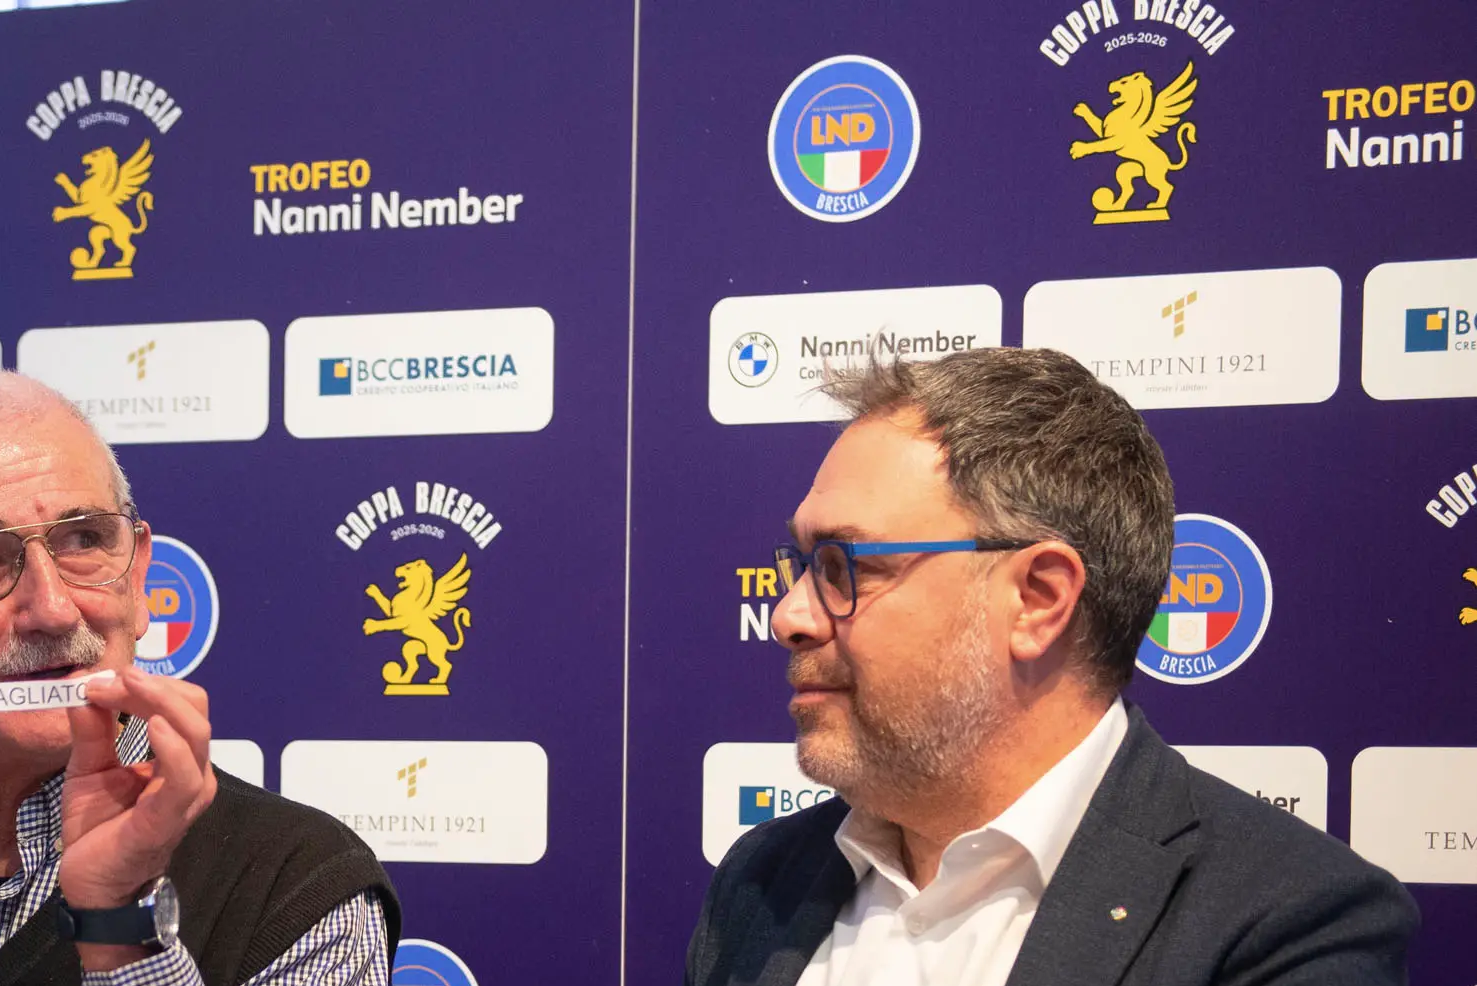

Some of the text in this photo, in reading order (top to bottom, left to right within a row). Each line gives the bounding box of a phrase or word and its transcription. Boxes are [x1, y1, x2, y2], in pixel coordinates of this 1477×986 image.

[1104, 32, 1168, 52] 2025-2026
[26, 69, 183, 141] COPPA BRESCIA
[1322, 80, 1476, 121] TROFEO
[811, 112, 876, 146] LND
[1326, 119, 1463, 169] Nanni
[250, 159, 371, 192] TROFEO
[254, 187, 523, 235] Nanni Nember
[816, 191, 869, 212] BRESCIA
[801, 330, 976, 358] Nanni Nember
[357, 354, 517, 381] BCCBRESCIA
[1091, 353, 1267, 377] TEMPINI 1921
[173, 396, 212, 413] 1921
[1426, 464, 1477, 528] COP
[336, 481, 502, 550] COPPA BRESCIA
[145, 588, 180, 617] ND
[1159, 572, 1223, 607] ND
[1160, 654, 1216, 675] BRESCIA
[339, 814, 485, 833] TEMPINI 1921
